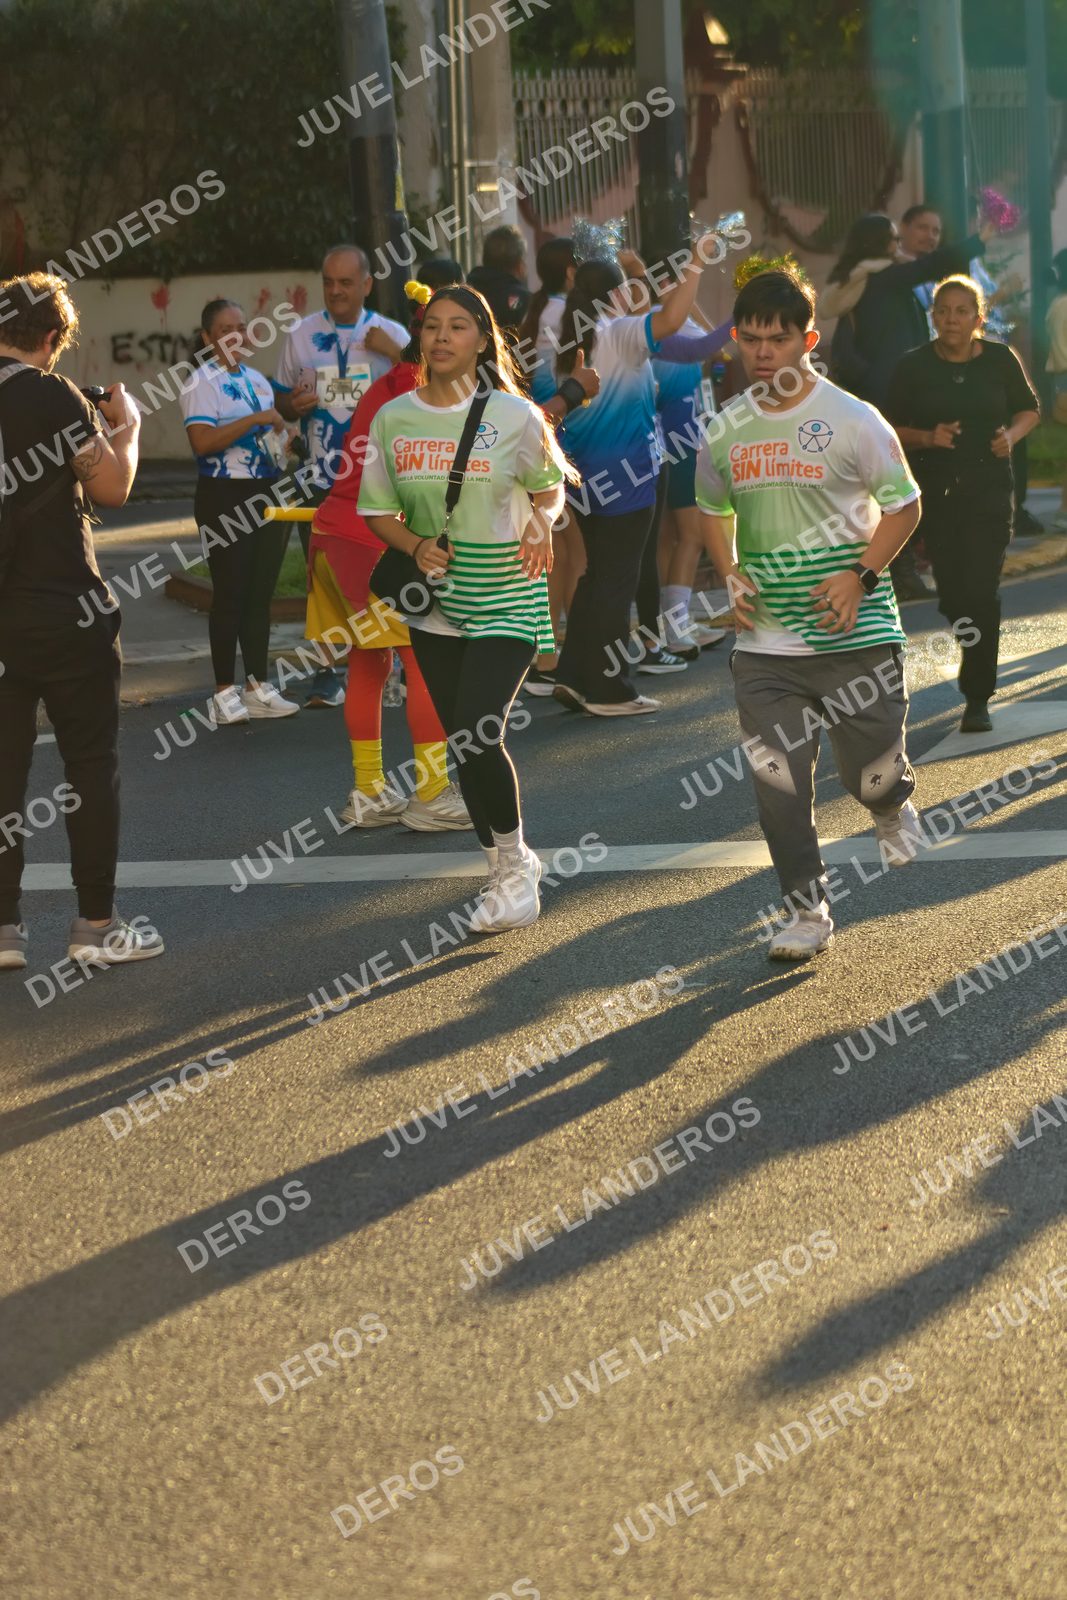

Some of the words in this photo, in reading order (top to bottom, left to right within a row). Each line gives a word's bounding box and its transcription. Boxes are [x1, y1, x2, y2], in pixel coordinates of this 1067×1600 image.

[393, 439, 455, 454] Carrera
[730, 442, 789, 462] Carrera
[395, 454, 424, 473] SIN
[428, 454, 491, 472] límtes
[732, 460, 761, 482] SIN
[765, 458, 824, 479] límites
